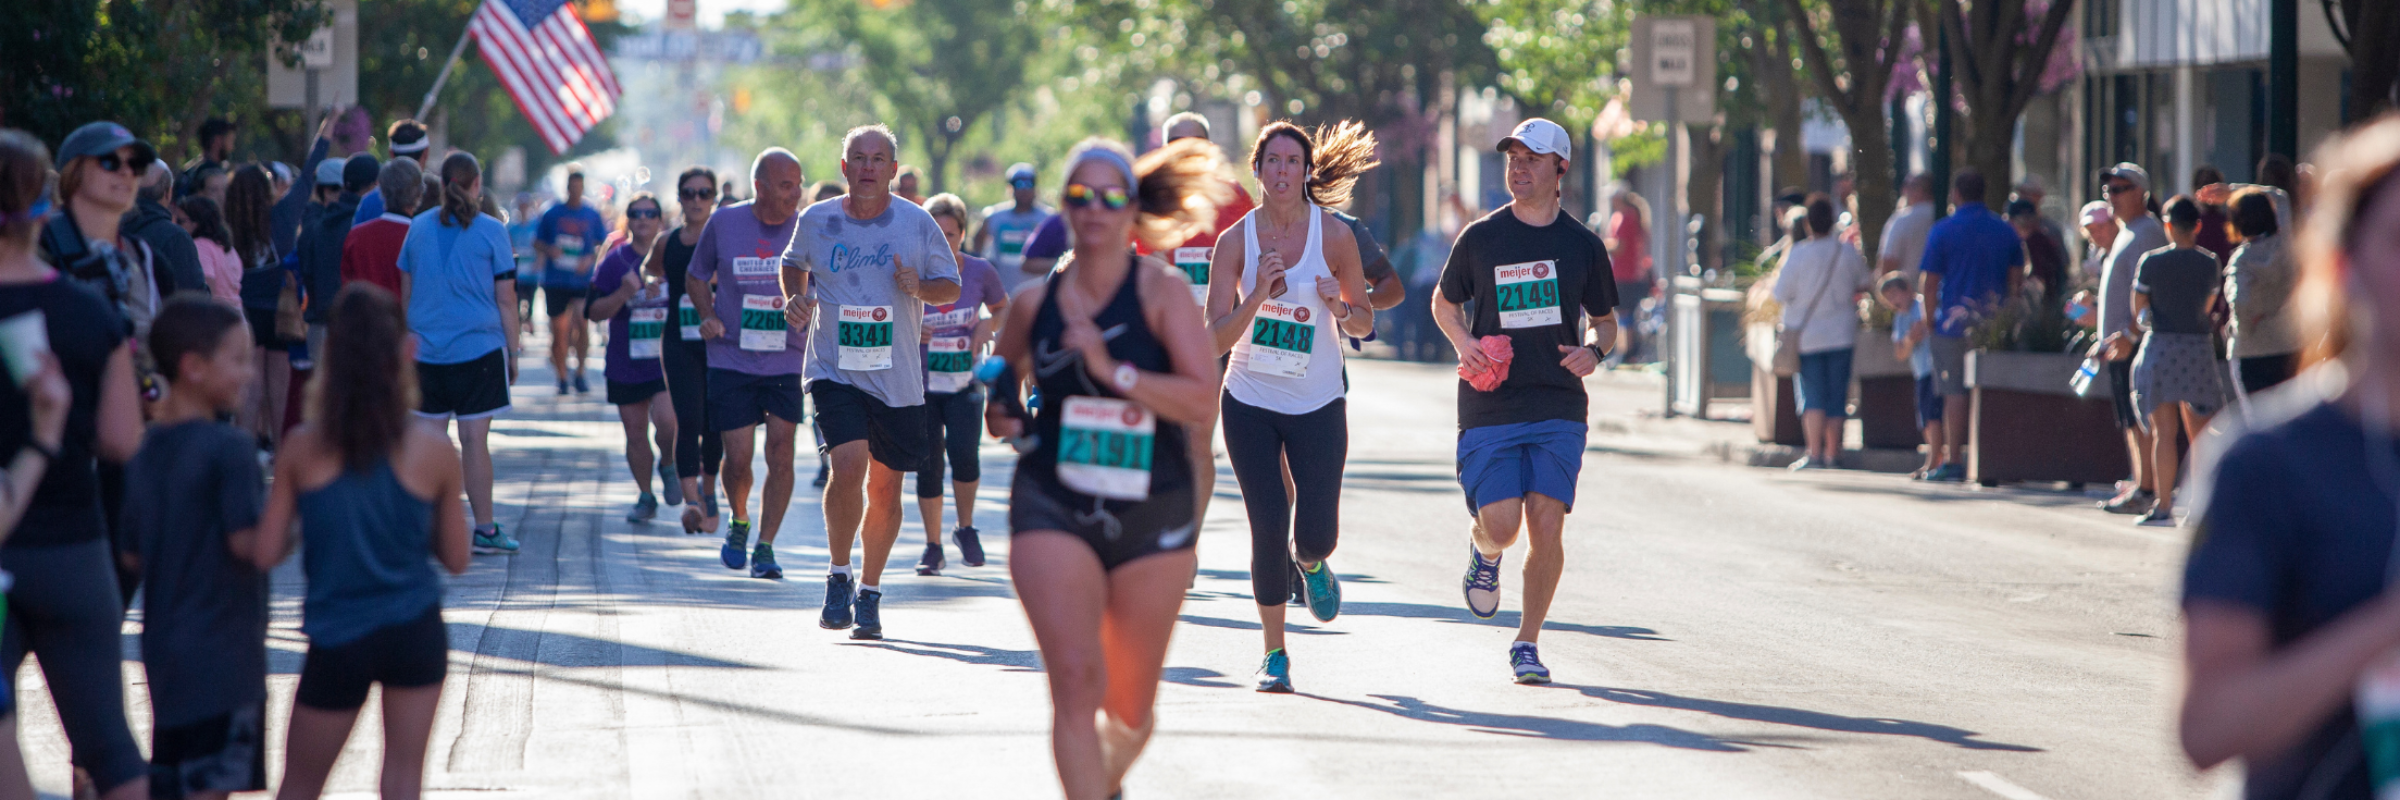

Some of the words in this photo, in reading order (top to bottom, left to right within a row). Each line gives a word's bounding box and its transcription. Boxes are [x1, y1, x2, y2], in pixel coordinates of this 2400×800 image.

[830, 243, 892, 273] Climb
[1500, 266, 1531, 279] meijer
[1499, 281, 1557, 311] 2149
[843, 308, 871, 319] meijer
[1262, 303, 1293, 316] meijer
[841, 323, 889, 347] 3341
[1254, 318, 1311, 352] 2148
[929, 353, 972, 371] 2265
[1065, 429, 1142, 470] 2191
